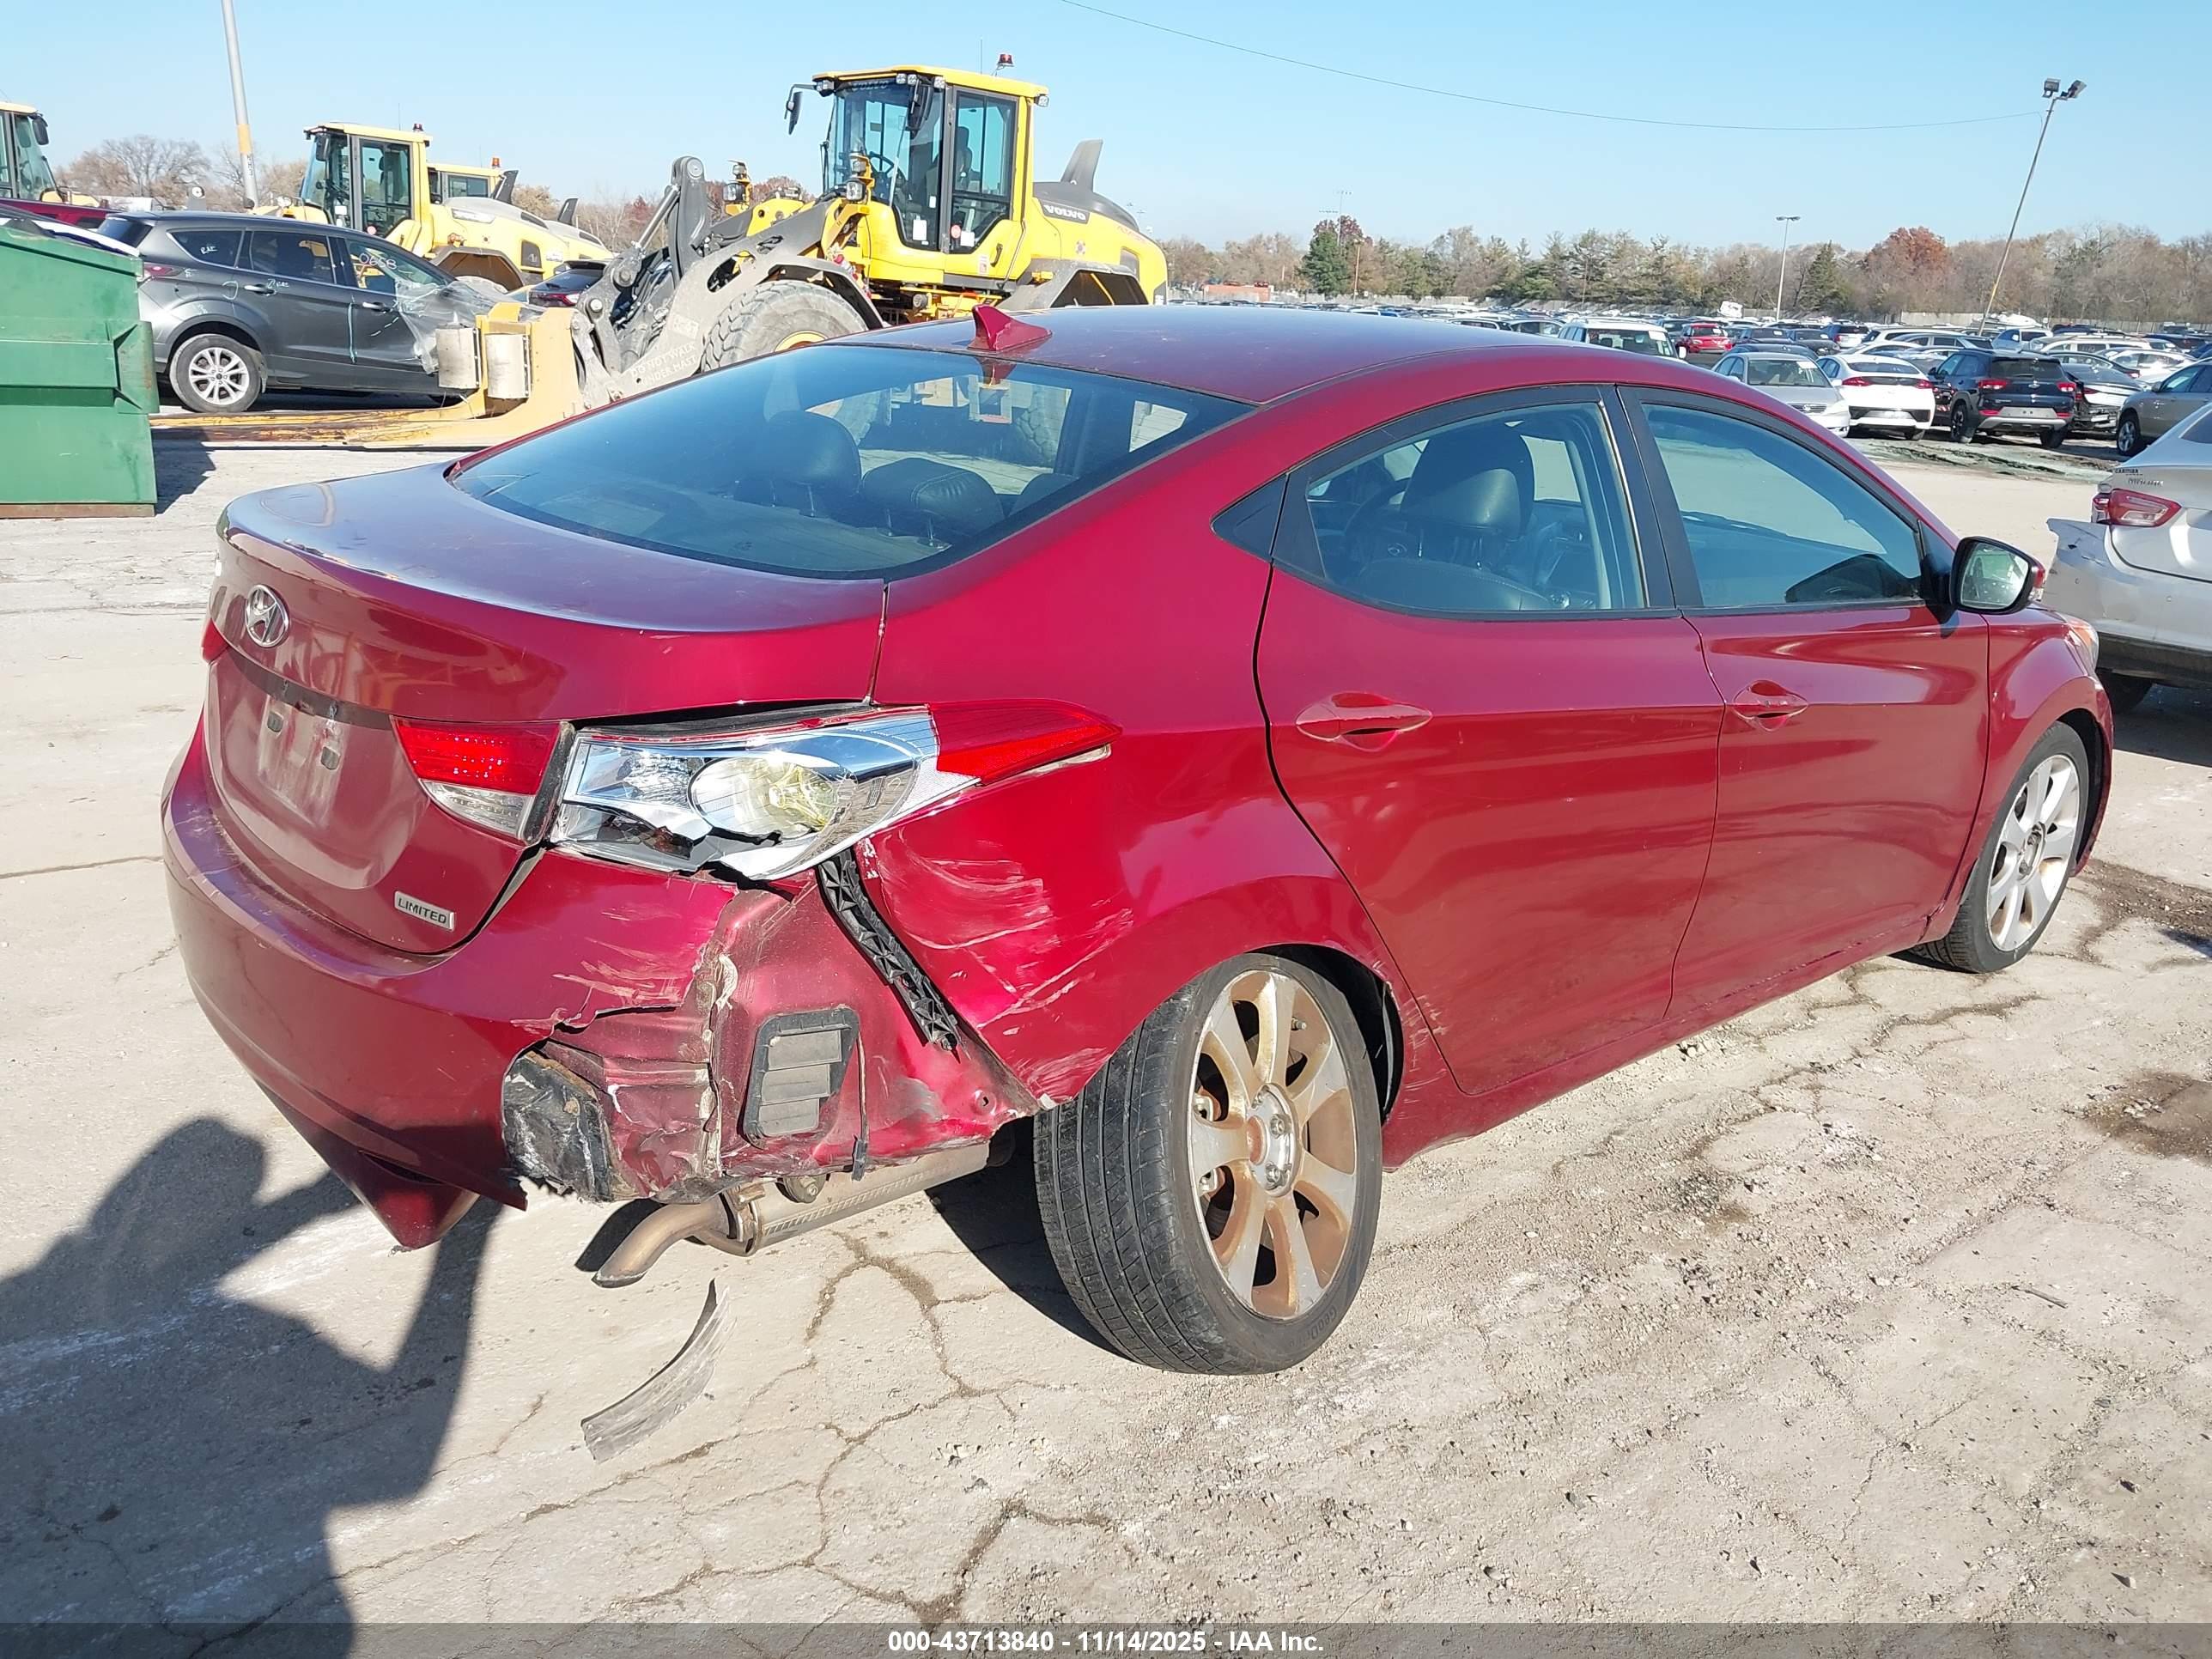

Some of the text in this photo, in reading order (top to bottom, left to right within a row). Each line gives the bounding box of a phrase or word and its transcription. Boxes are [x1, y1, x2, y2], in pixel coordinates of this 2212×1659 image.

[1043, 204, 1086, 221] VOLVO
[358, 252, 398, 270] 0658
[666, 342, 695, 358] WALK
[672, 355, 697, 372] MAST
[398, 897, 447, 924] LIMITED
